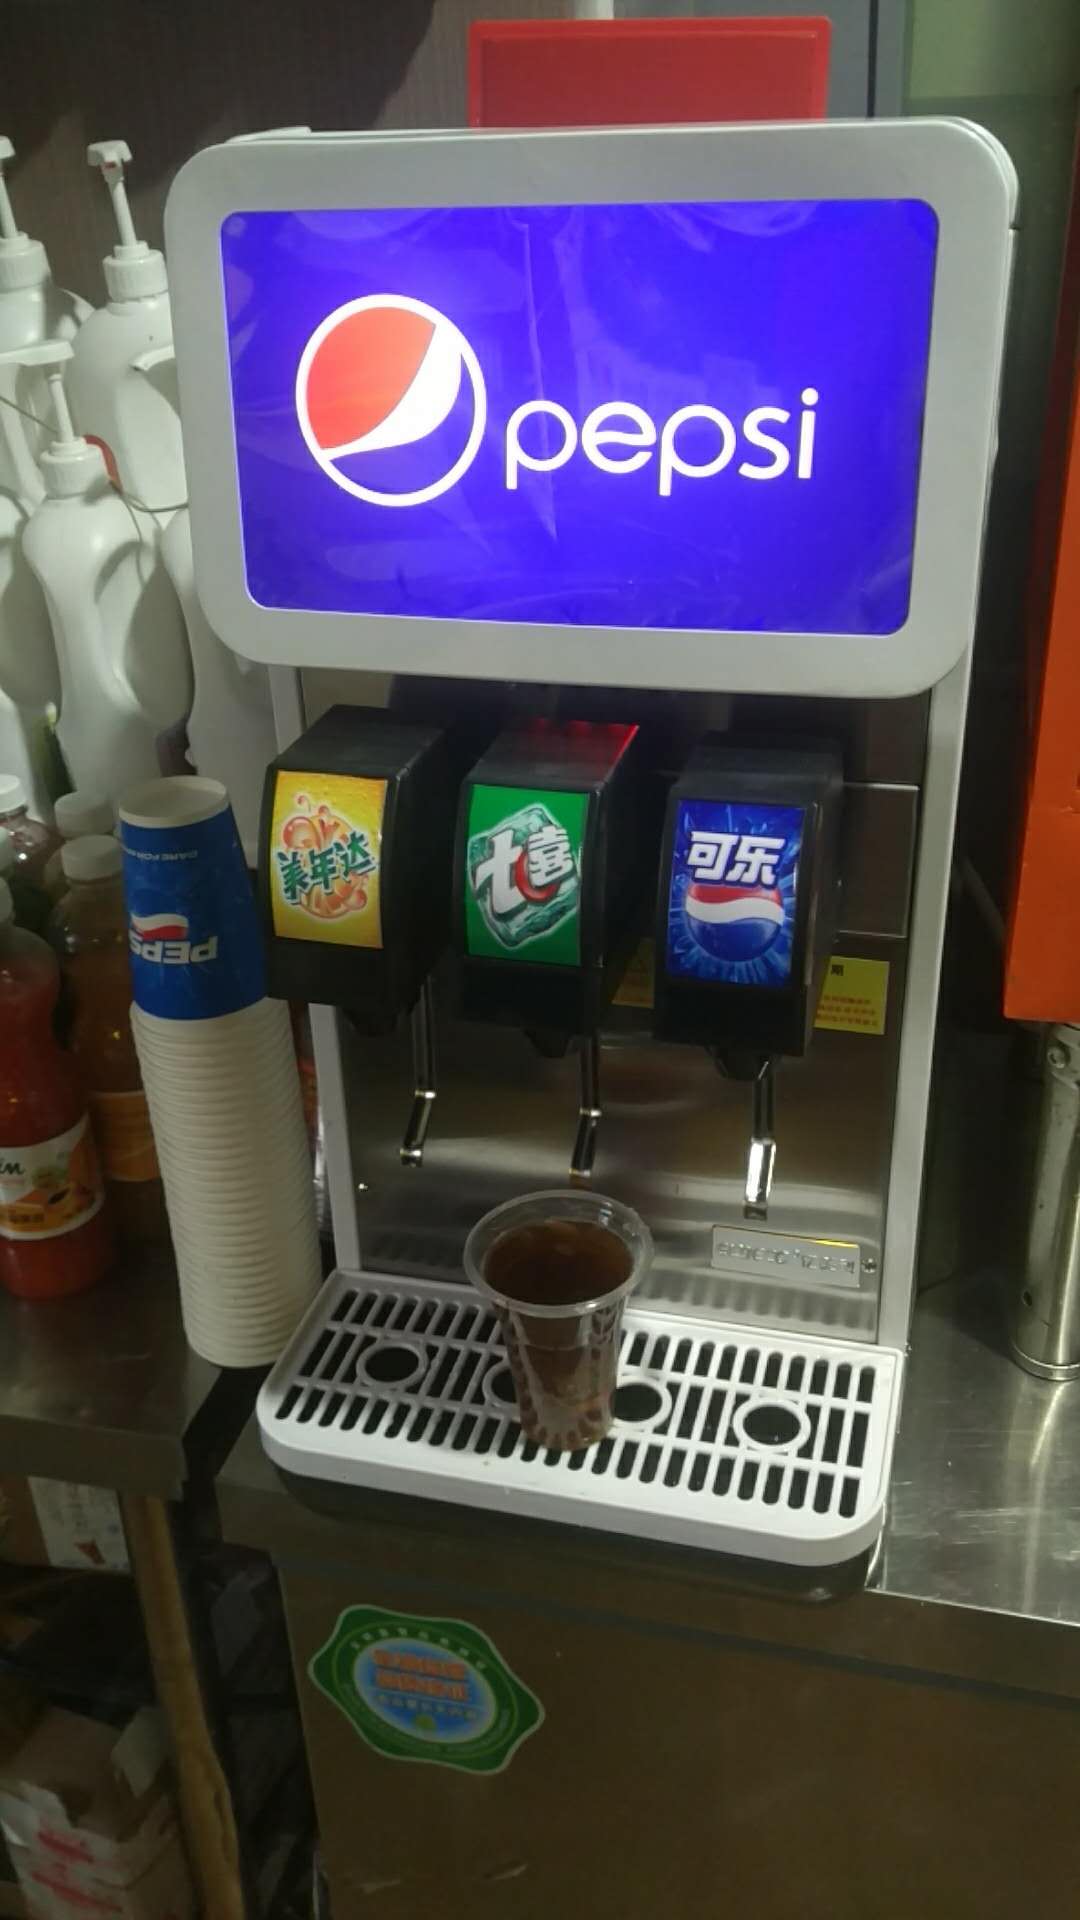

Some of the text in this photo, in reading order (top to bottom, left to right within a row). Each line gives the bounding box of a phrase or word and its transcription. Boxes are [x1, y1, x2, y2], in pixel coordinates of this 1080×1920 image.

[505, 387, 819, 497] pepsi
[276, 829, 376, 904] 美年达
[475, 825, 573, 913] 七喜
[687, 831, 786, 886] 可乐
